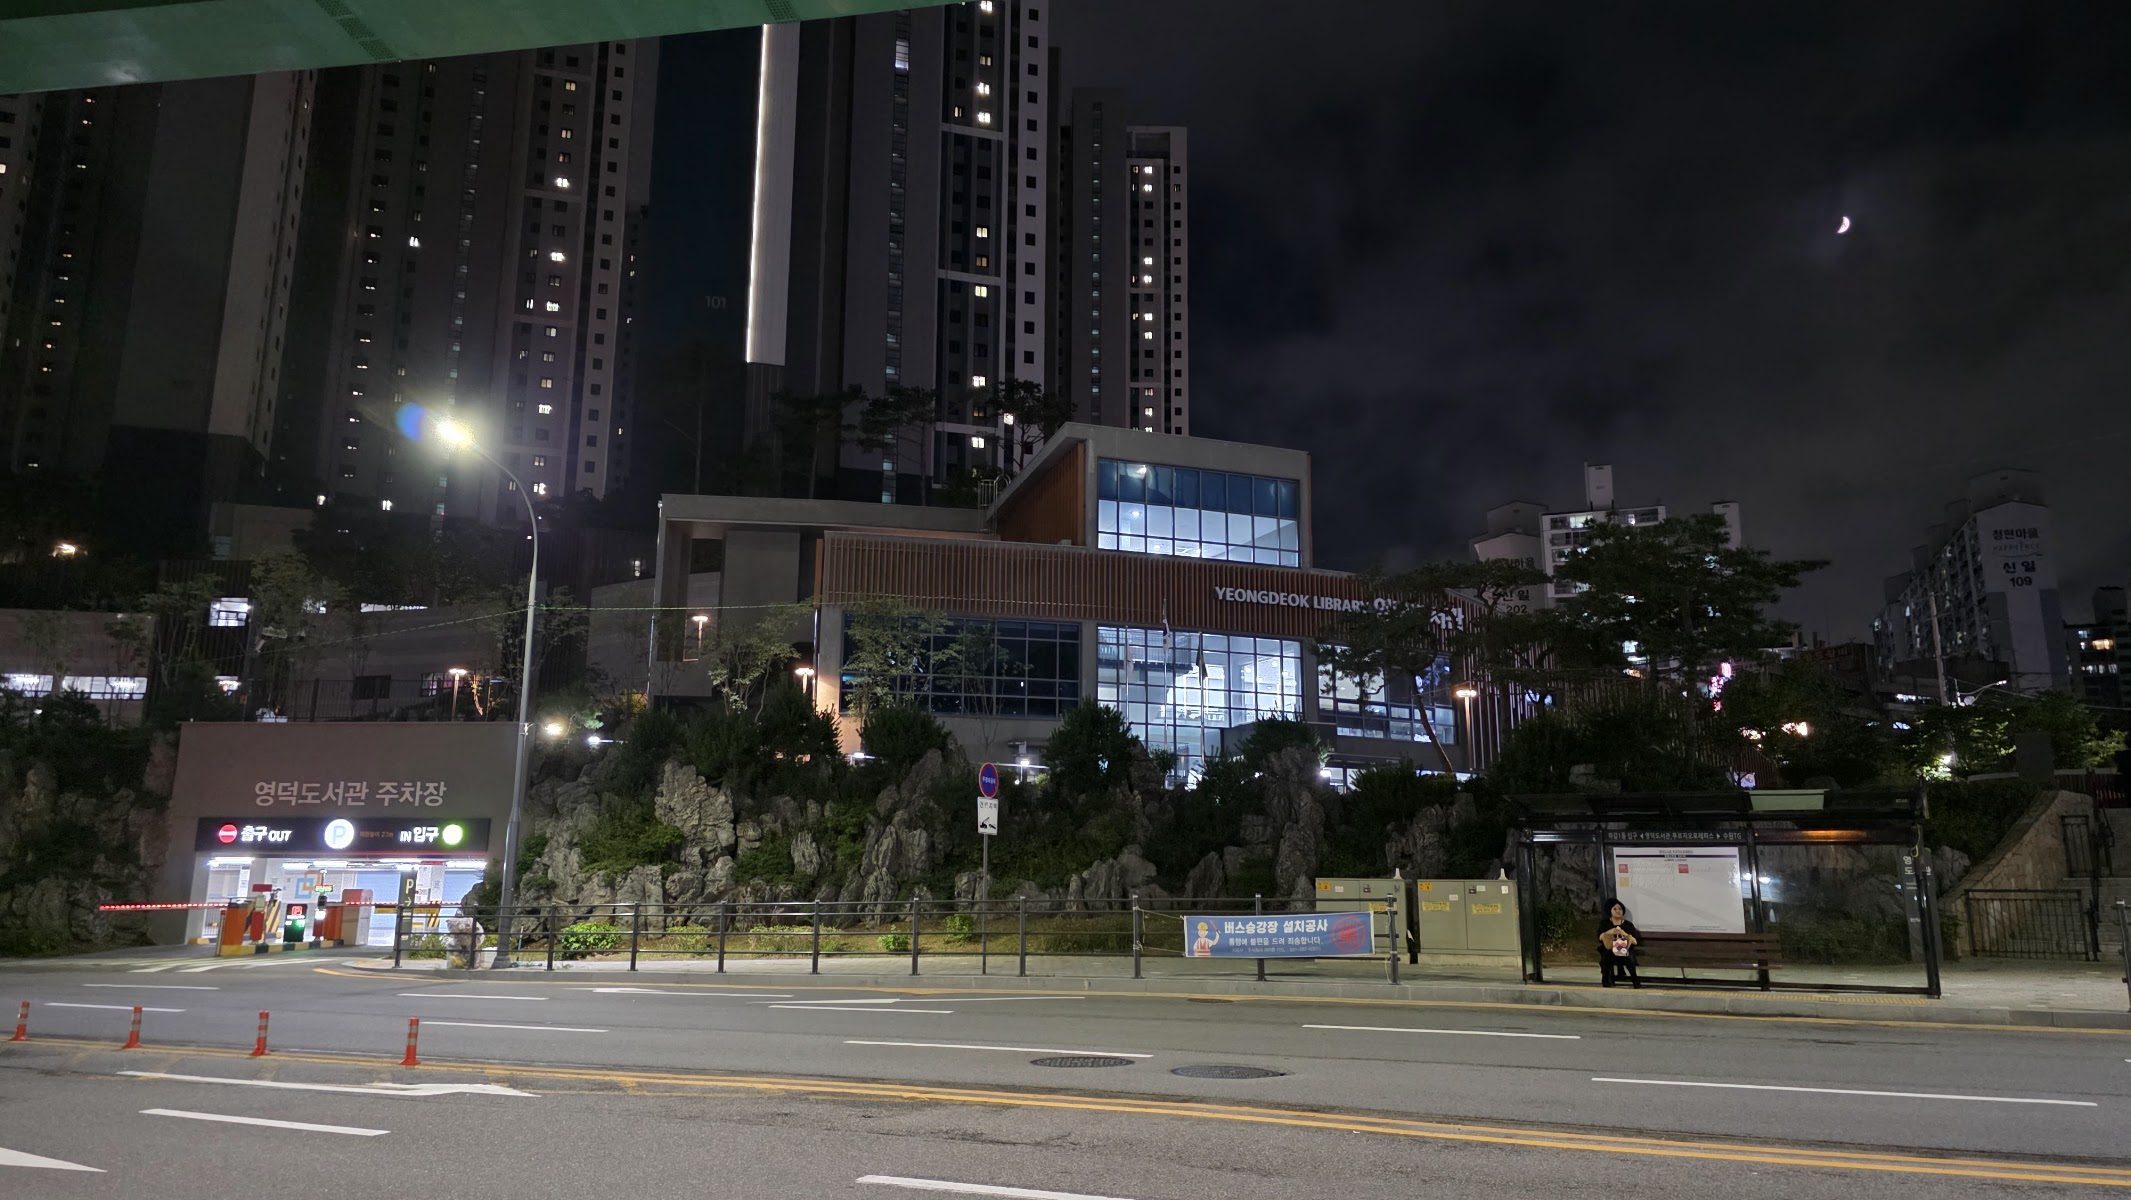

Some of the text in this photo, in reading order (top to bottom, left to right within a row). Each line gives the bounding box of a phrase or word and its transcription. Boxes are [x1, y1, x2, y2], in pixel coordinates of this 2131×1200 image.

[706, 296, 726, 309] 101
[2009, 577, 2032, 587] 109
[1215, 586, 1309, 608] YEONGDEOK
[1506, 604, 1527, 614] 202
[254, 781, 447, 807] 영덕도서관 주차장
[240, 826, 293, 842] 출구 OUT
[333, 825, 346, 844] P
[400, 826, 439, 843] IN 입구
[406, 879, 414, 894] P
[1224, 919, 1328, 934] 버스승강장 설치공사
[1228, 937, 1248, 946] 통행에
[1249, 937, 1269, 946] 불편을
[1271, 937, 1285, 945] 드려
